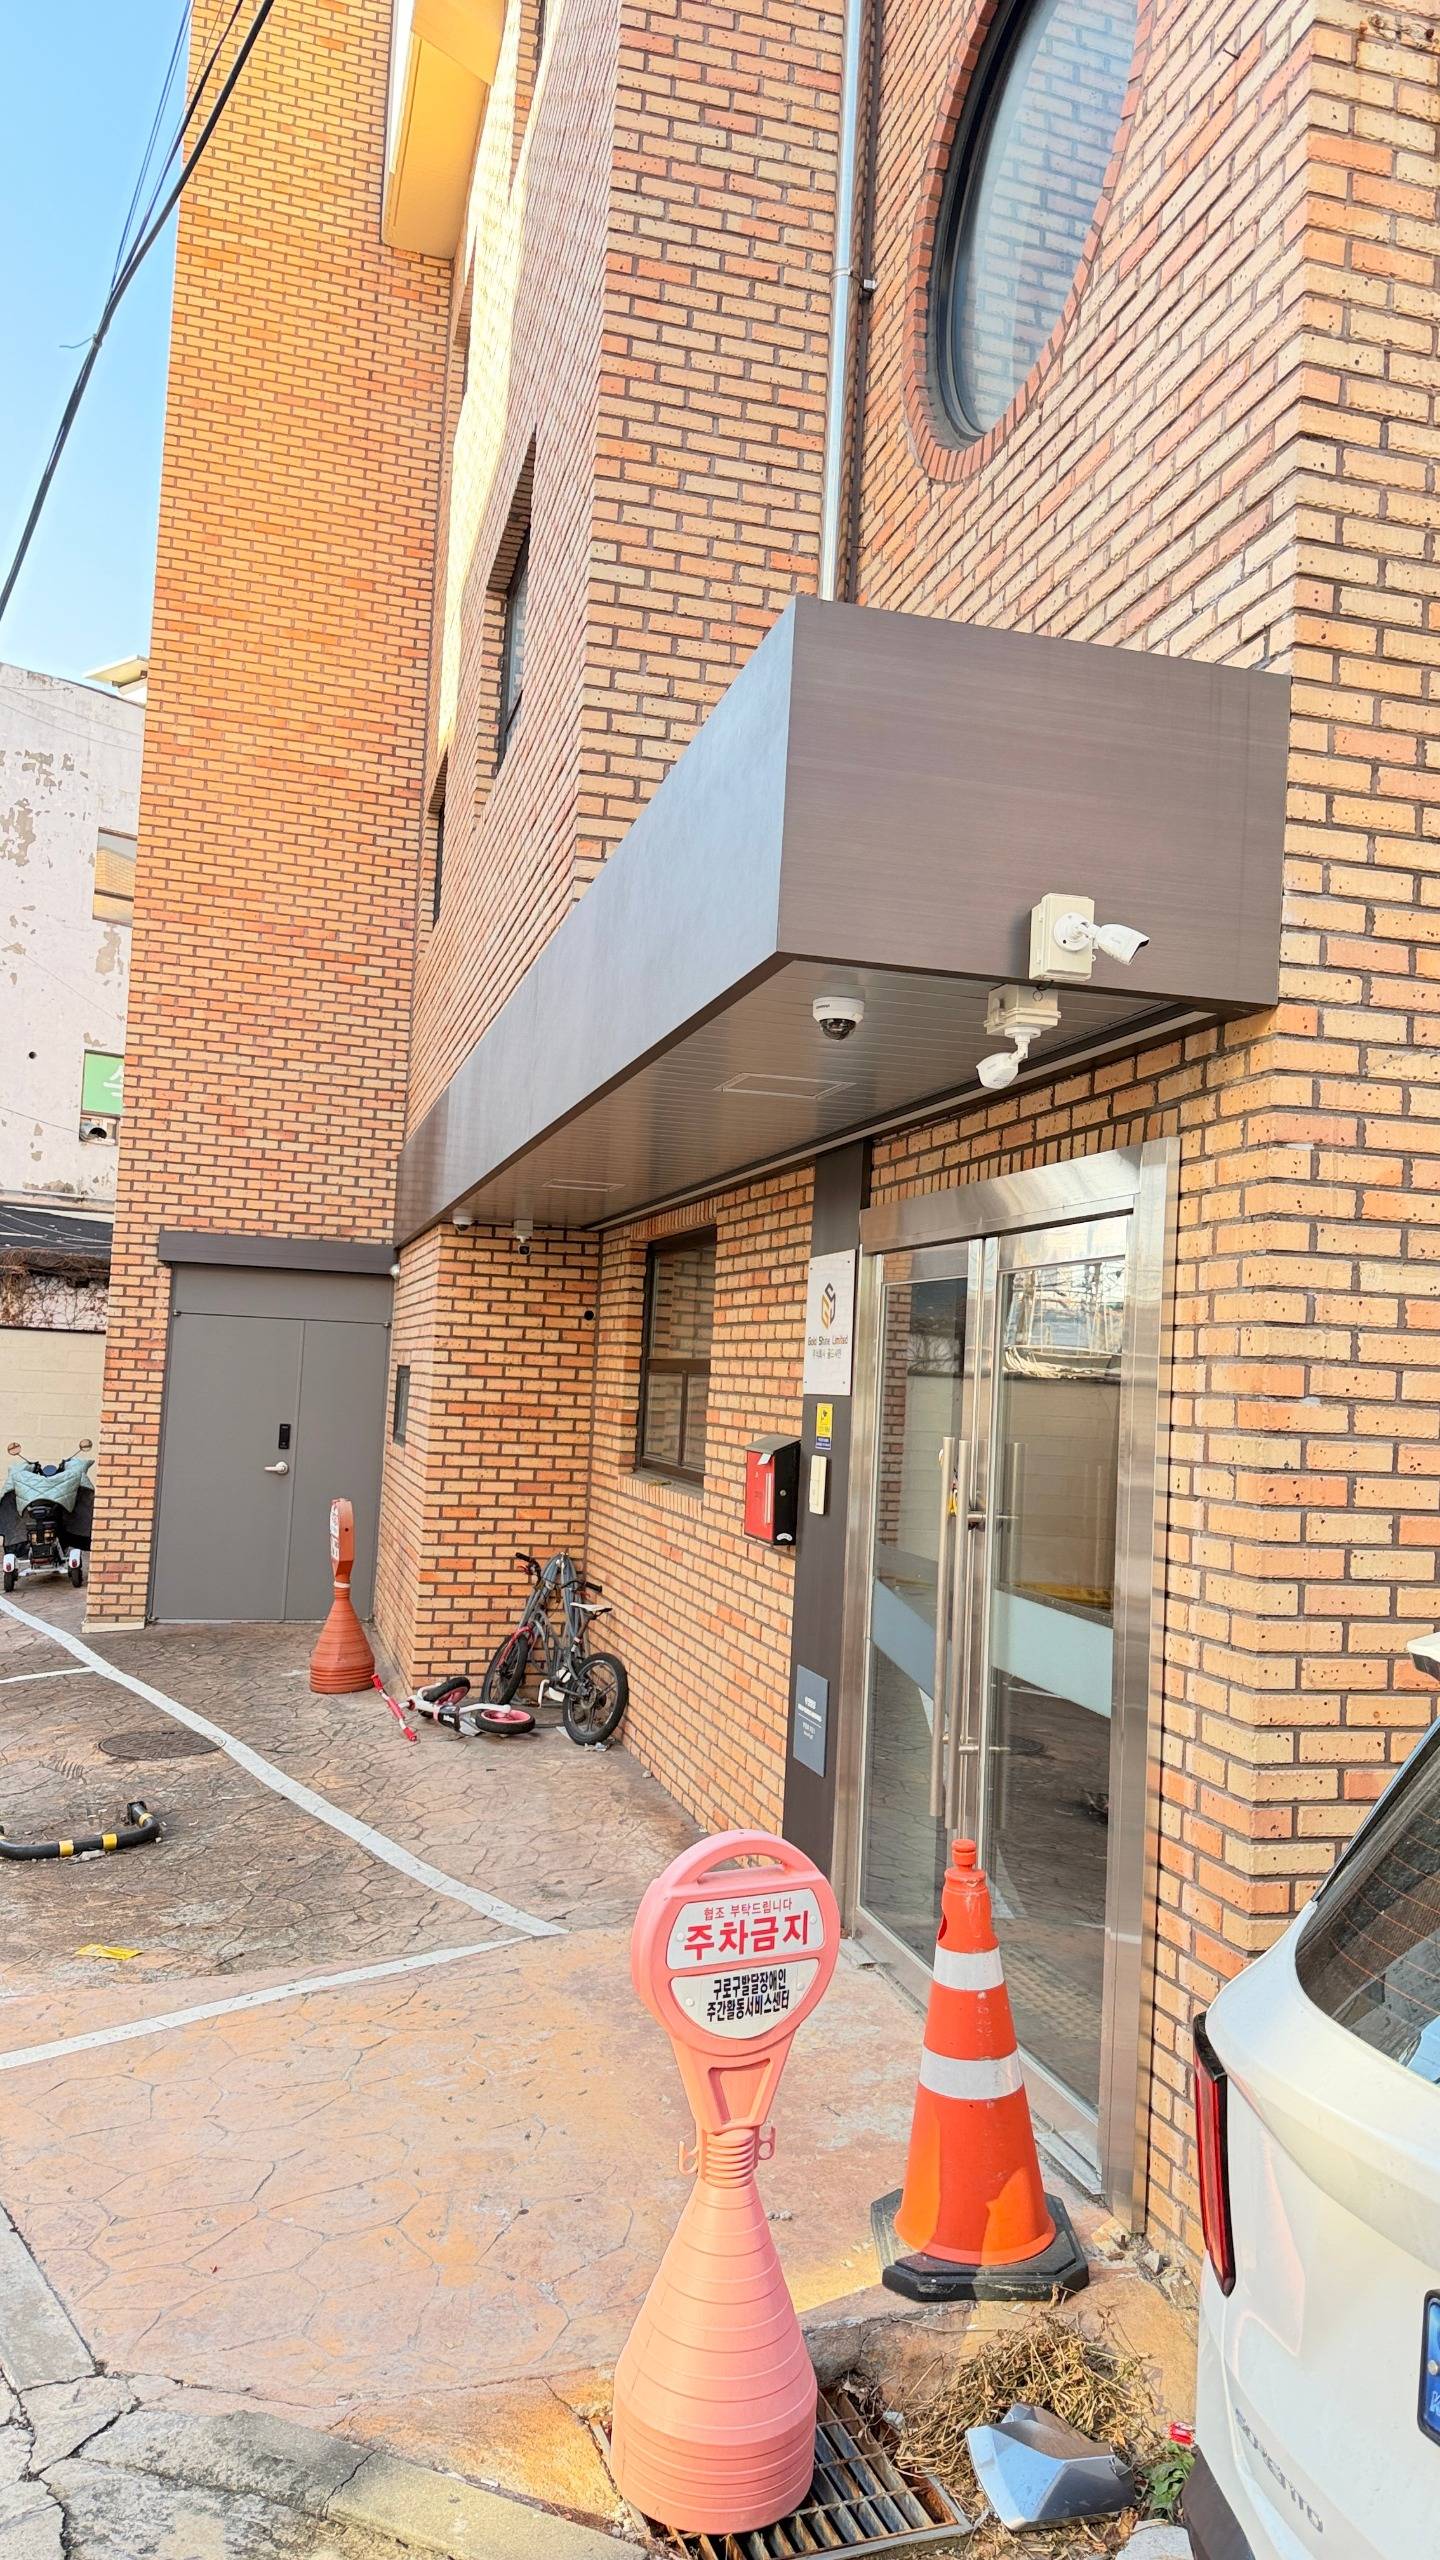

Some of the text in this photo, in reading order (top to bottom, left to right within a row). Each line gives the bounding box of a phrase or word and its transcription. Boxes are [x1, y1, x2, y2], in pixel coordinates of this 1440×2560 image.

[704, 1906, 725, 1921] 협조
[684, 1910, 808, 1961] 주차금지
[713, 1968, 787, 2000] 구로구발달장애인
[707, 1989, 790, 2022] 주간활동서비스센터
